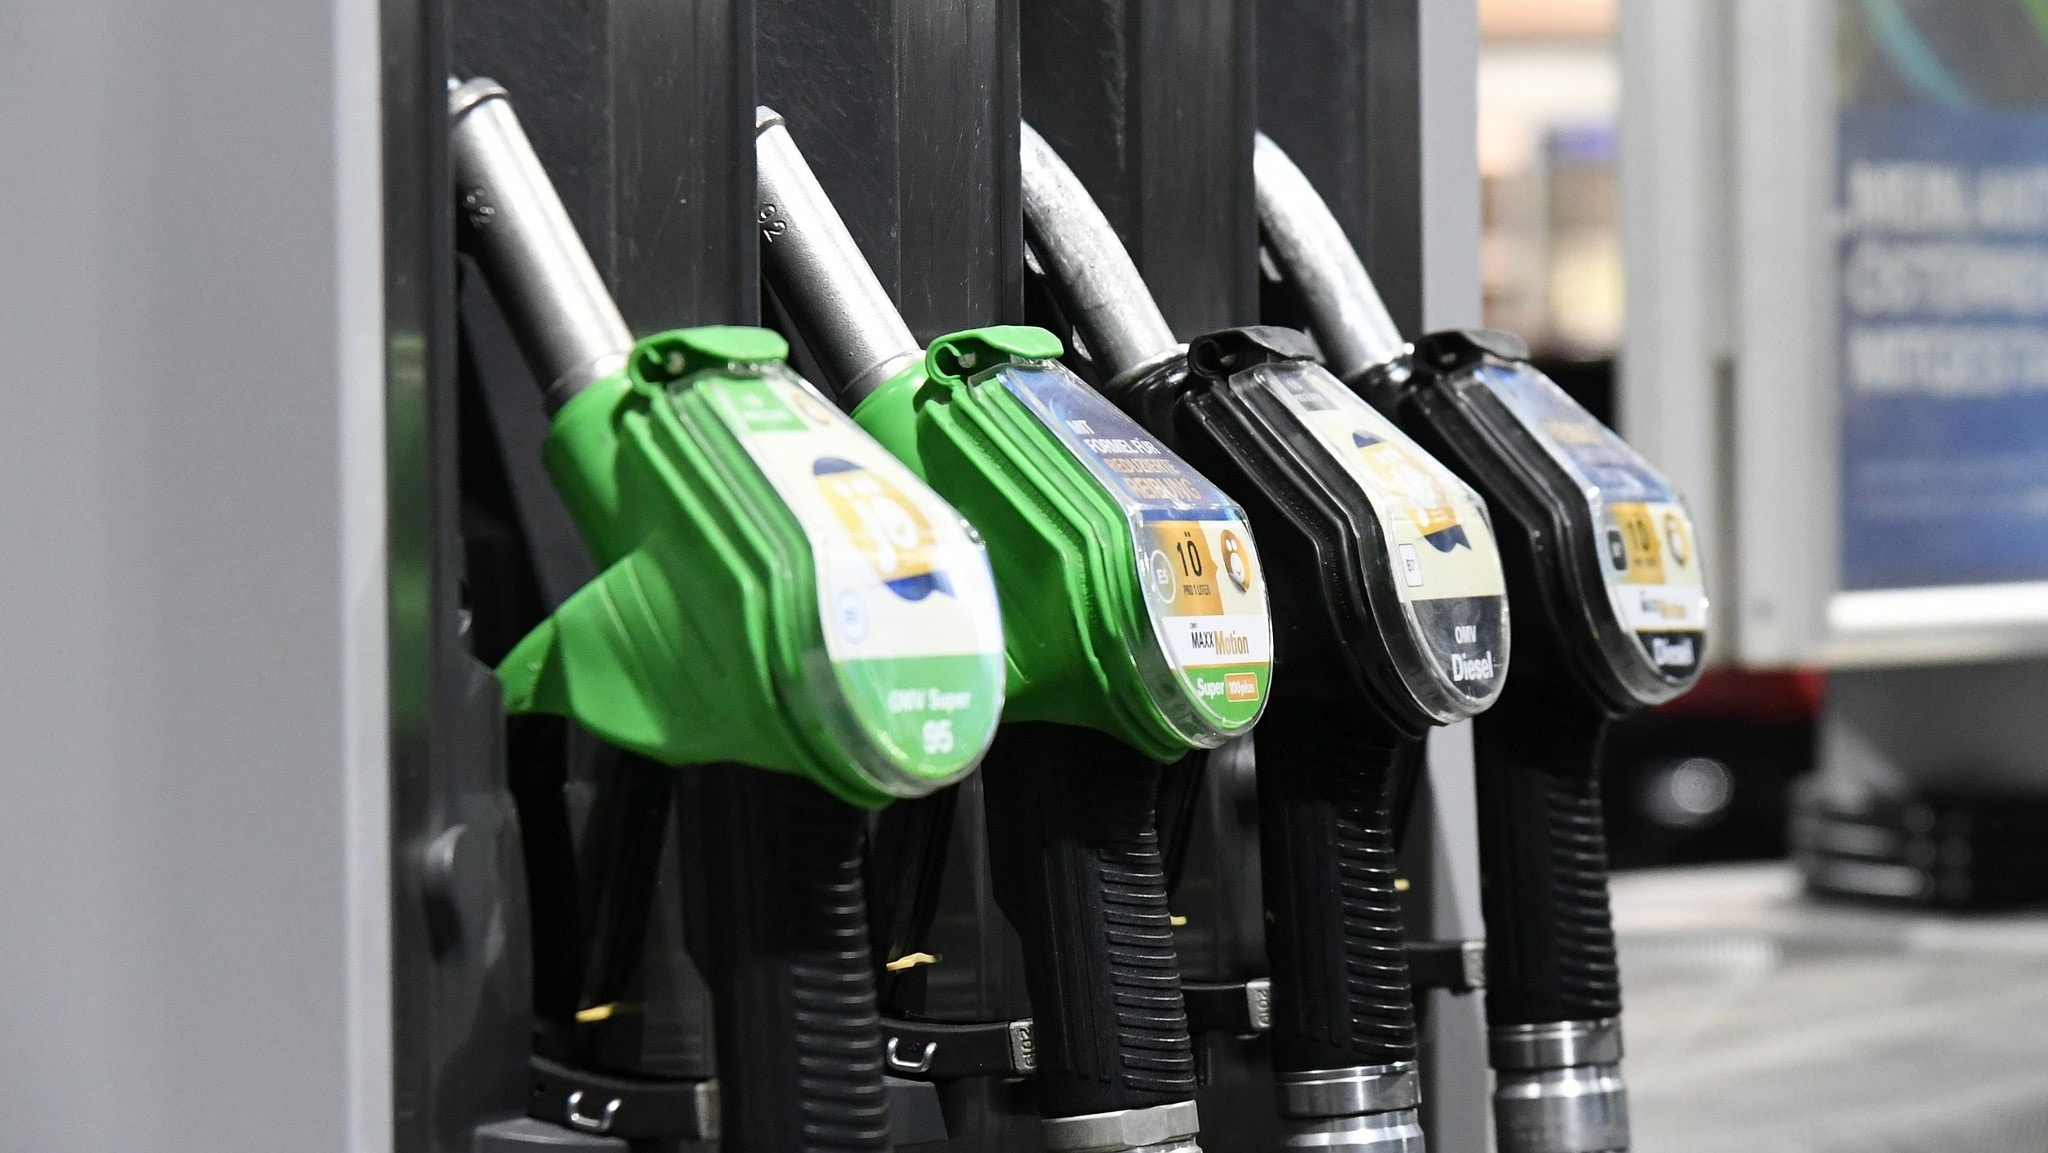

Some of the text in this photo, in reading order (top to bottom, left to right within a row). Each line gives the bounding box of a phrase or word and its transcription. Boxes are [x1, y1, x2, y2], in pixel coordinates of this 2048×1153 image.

[1065, 420, 1095, 435] MIT
[1083, 436, 1161, 455] FORMEL FÜR
[1103, 458, 1180, 474] REDUZIERTE
[1123, 477, 1202, 500] REIBUNG
[1454, 624, 1477, 645] OMV
[1450, 650, 1495, 682] Diesel
[887, 686, 971, 714] OMV Super
[1197, 677, 1256, 700] Super 100plus
[922, 719, 955, 755] 95
